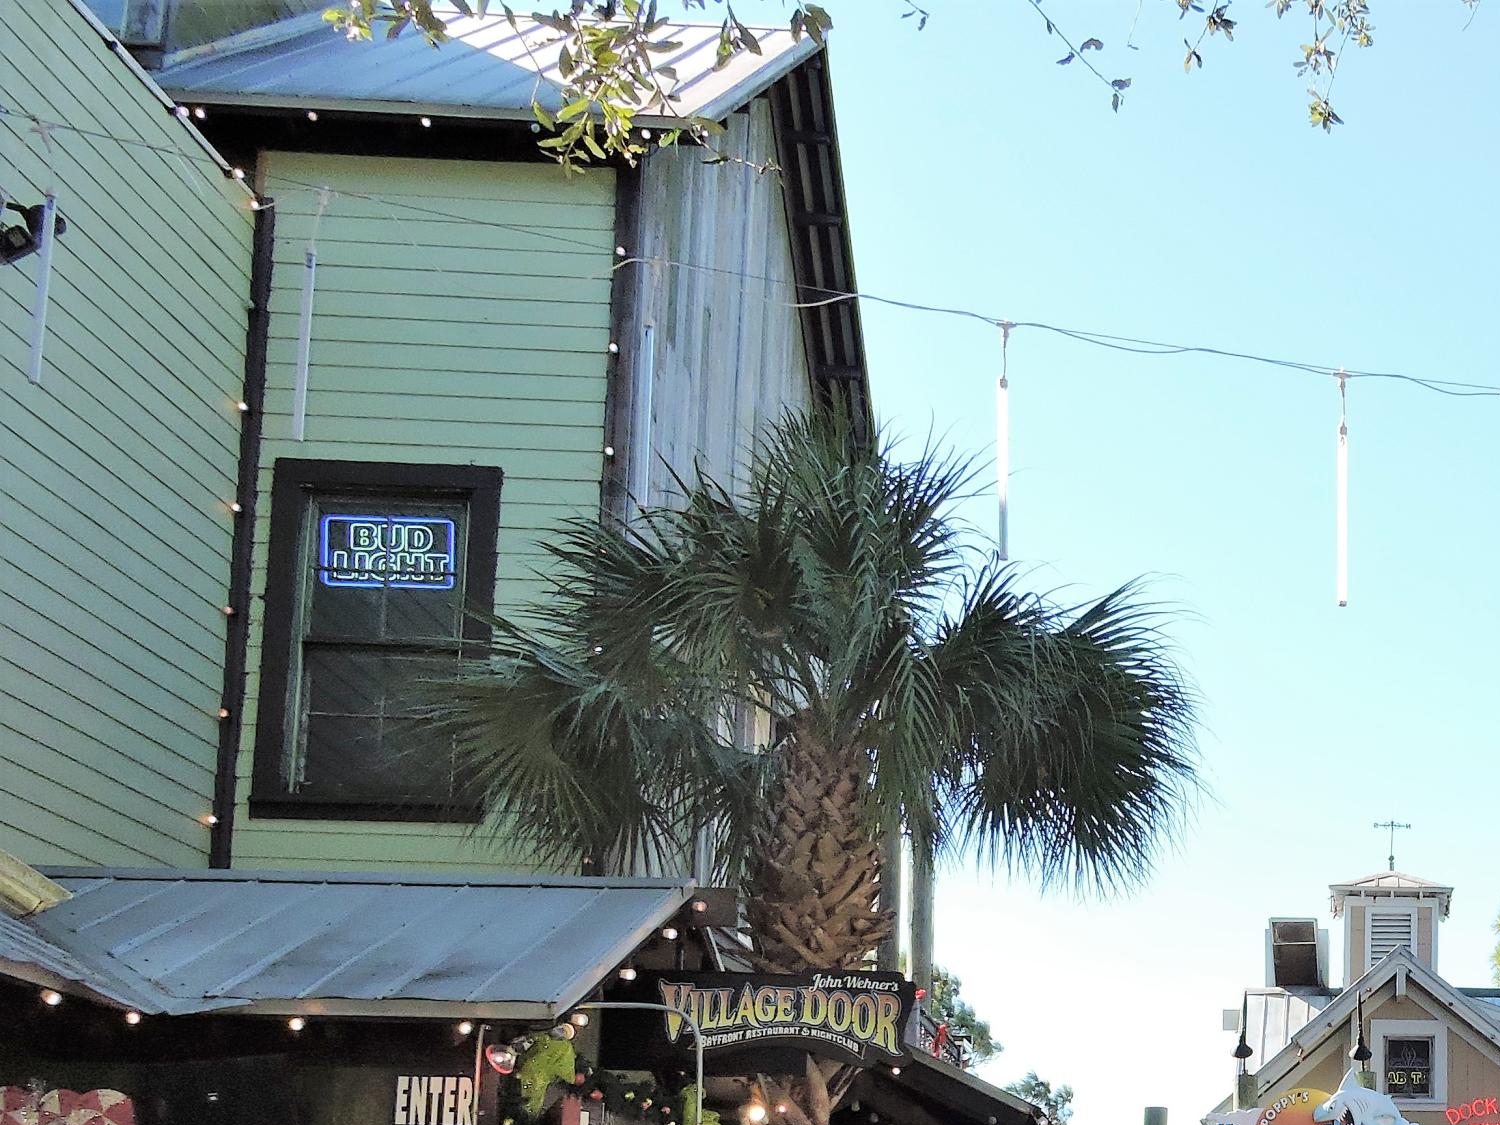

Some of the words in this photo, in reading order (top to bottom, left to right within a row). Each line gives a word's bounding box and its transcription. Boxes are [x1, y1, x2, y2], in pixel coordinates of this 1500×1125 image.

[350, 523, 433, 552] BUD
[333, 551, 450, 580] LIGHT
[809, 973, 842, 992] John
[843, 976, 900, 992] Wehner's
[658, 978, 797, 1043] VILLAGE
[799, 988, 903, 1056] DOOR
[700, 1031, 744, 1047] BAYFRONT
[746, 1027, 800, 1039] RESTAURANT
[801, 1026, 809, 1036] &
[810, 1030, 860, 1052] NIGHTCLUB
[394, 1075, 473, 1125] ENTER
[1445, 1098, 1498, 1125] DOCK
